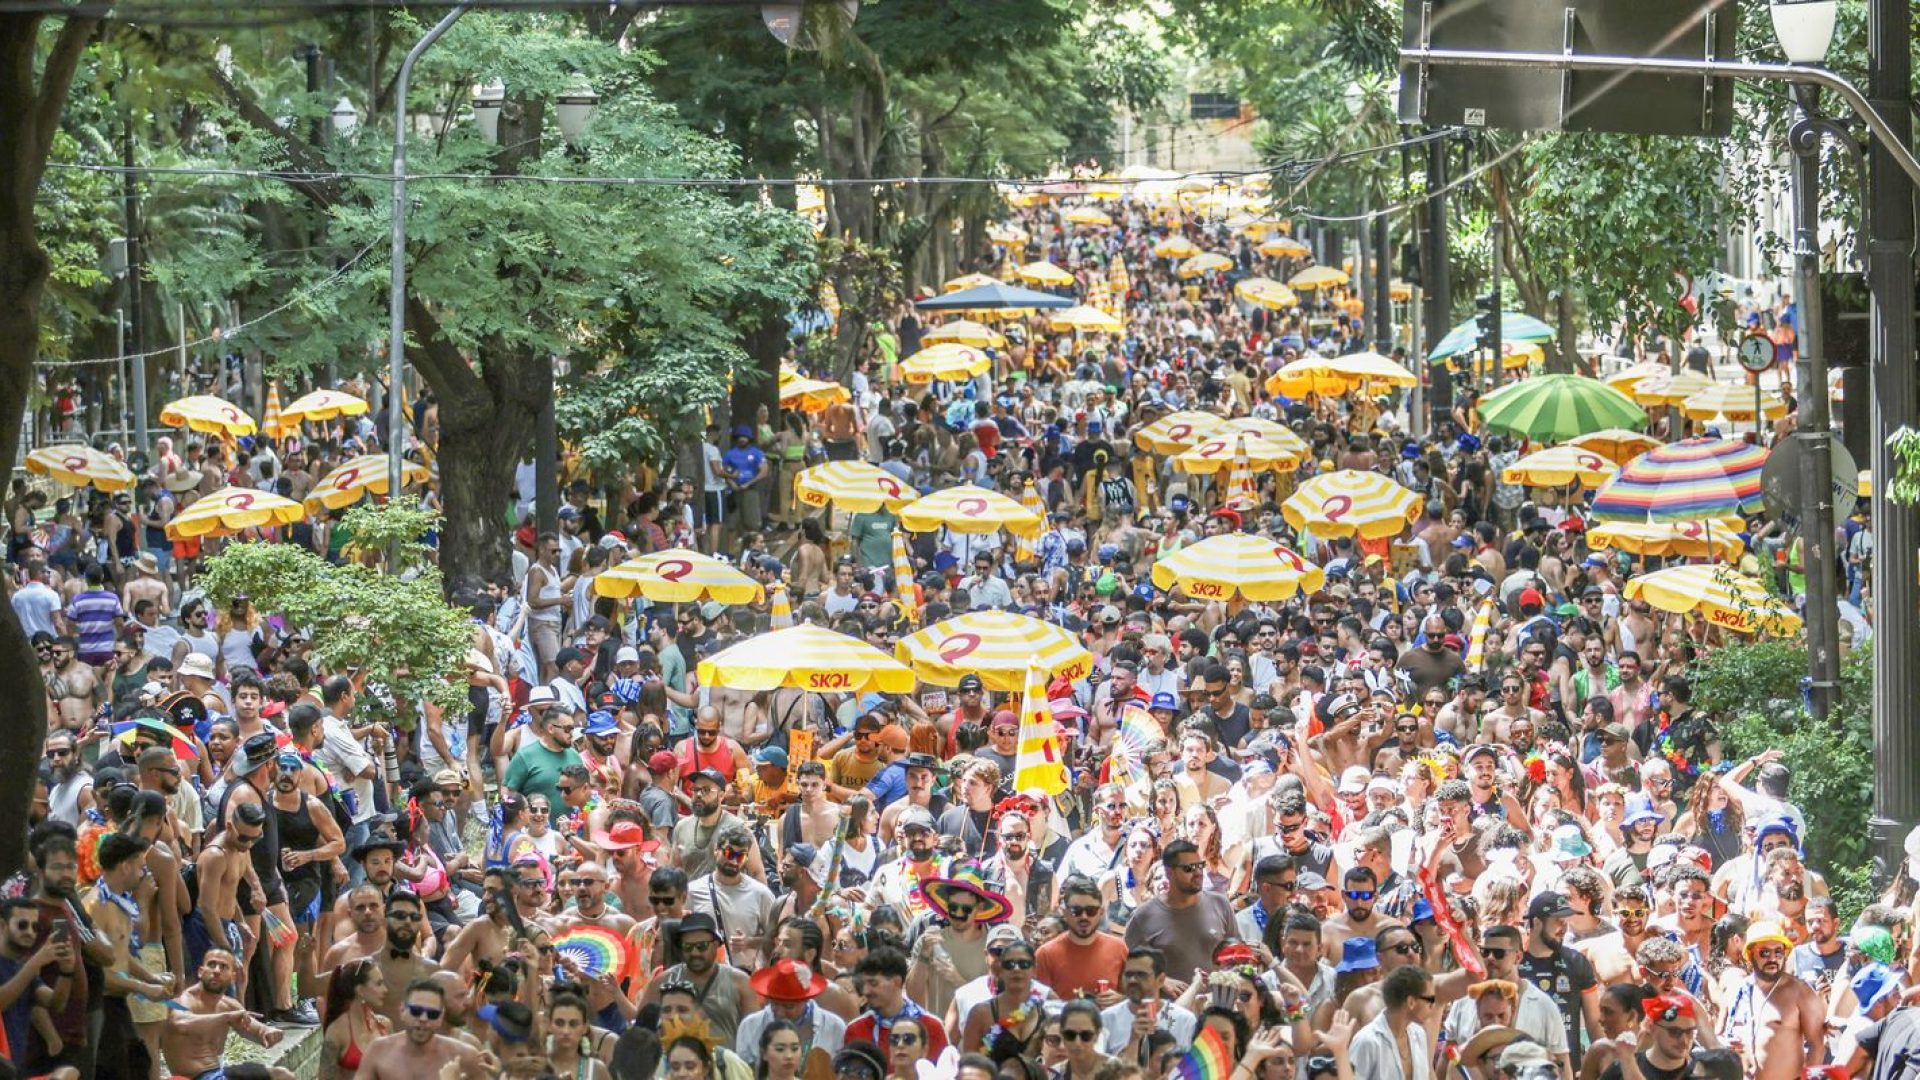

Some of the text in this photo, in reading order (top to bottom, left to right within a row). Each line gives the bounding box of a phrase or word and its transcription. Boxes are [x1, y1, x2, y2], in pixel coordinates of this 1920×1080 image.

[1191, 583, 1223, 597] SKOL
[1711, 609, 1746, 627] SKOL
[1061, 662, 1085, 682] SKOL
[810, 673, 851, 688] SKOL
